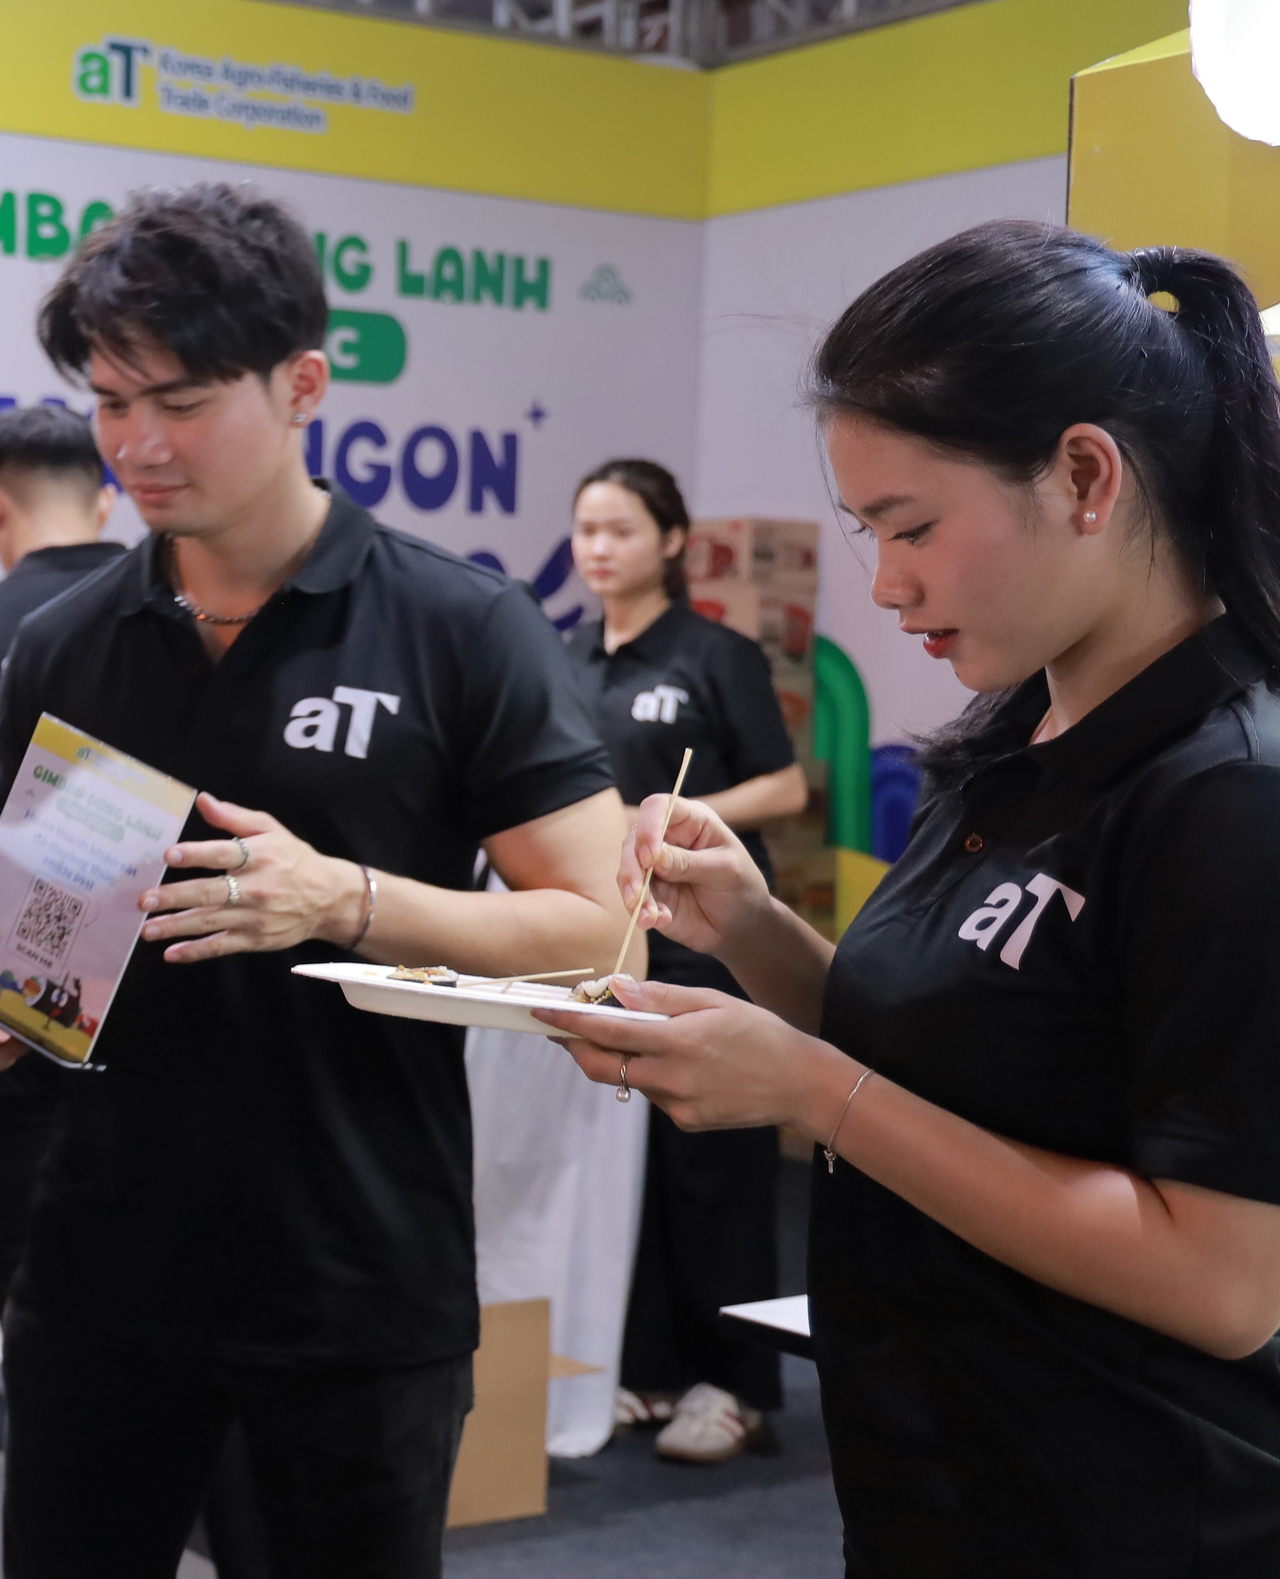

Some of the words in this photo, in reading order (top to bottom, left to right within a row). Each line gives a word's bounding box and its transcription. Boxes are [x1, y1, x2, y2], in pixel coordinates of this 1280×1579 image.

[75, 40, 151, 102] aT
[284, 685, 401, 759] aT
[631, 685, 689, 724] aT
[958, 872, 1086, 970] aT
